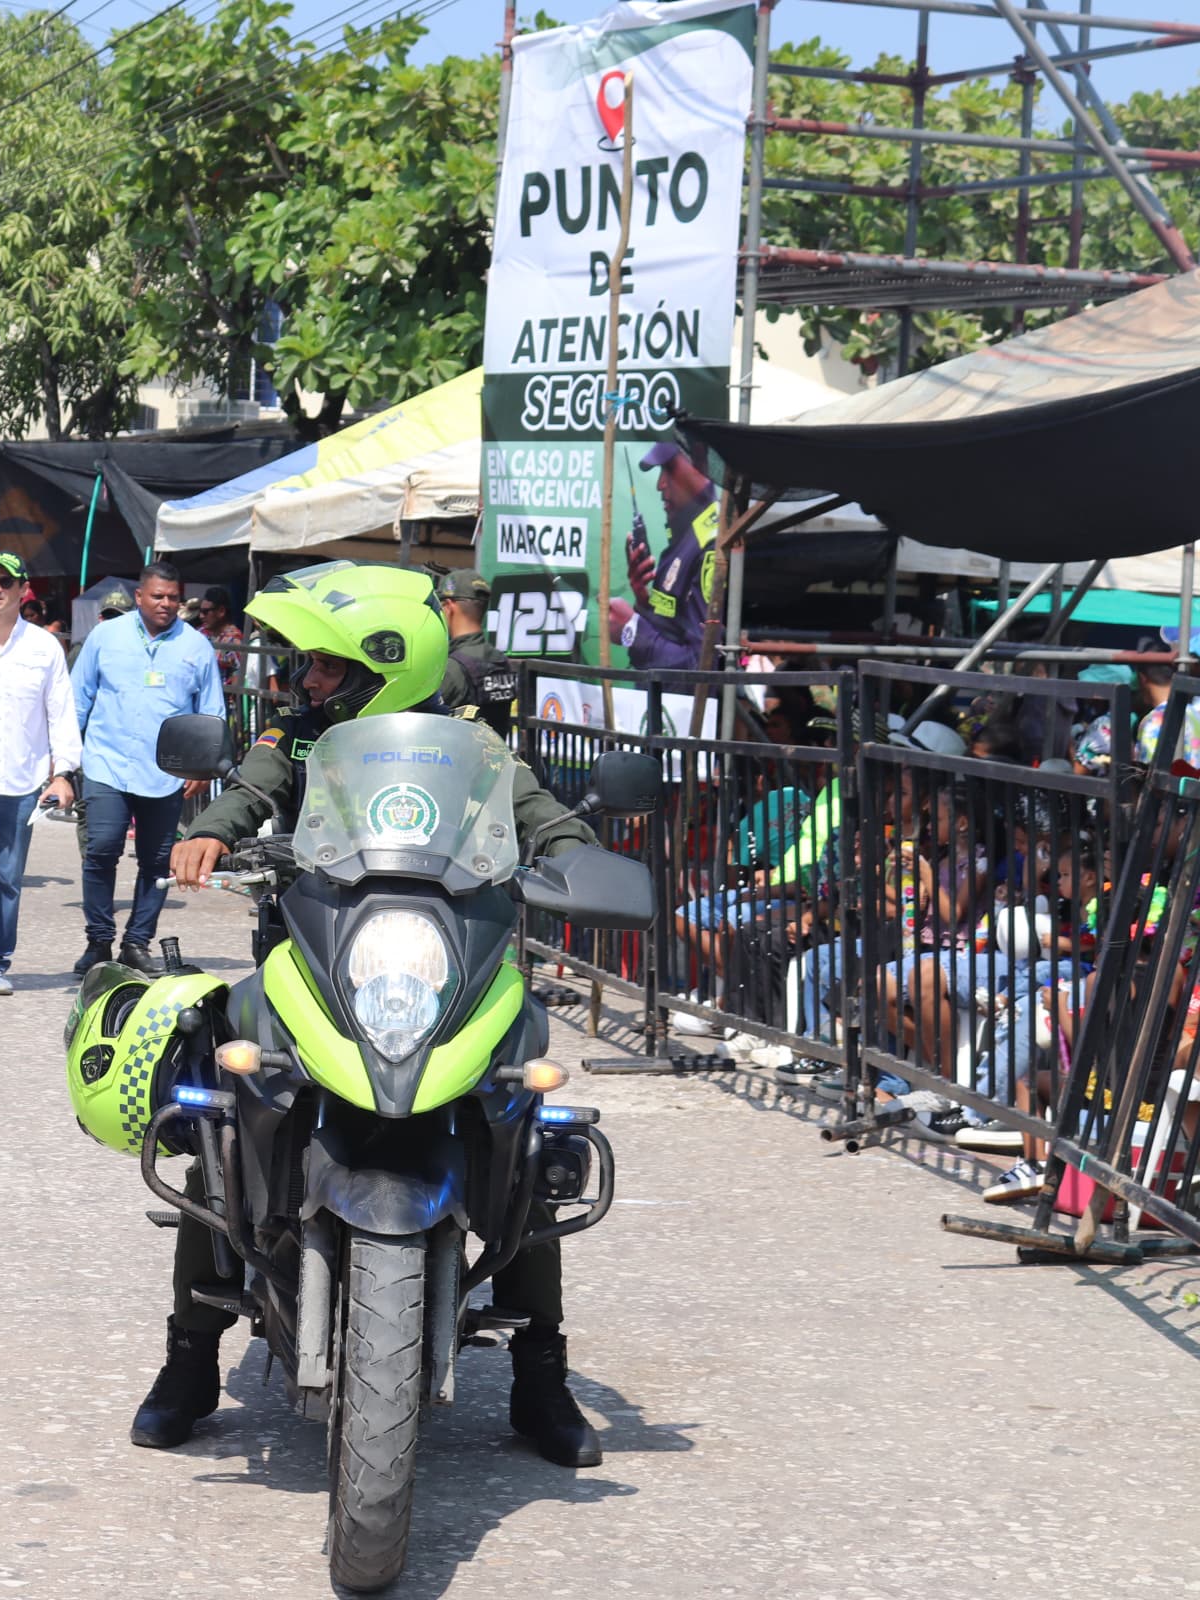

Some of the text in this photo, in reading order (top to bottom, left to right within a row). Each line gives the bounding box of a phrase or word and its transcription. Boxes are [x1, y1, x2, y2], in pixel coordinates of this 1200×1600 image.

[520, 151, 709, 238] PUNTO
[589, 248, 635, 296] DE
[511, 300, 700, 365] ATENCIÓN
[521, 371, 681, 432] SEGURO
[487, 448, 595, 478] EN CASO DE
[489, 479, 603, 509] EMERGENCIA
[500, 523, 583, 558] MARCAR
[495, 590, 584, 654] 123
